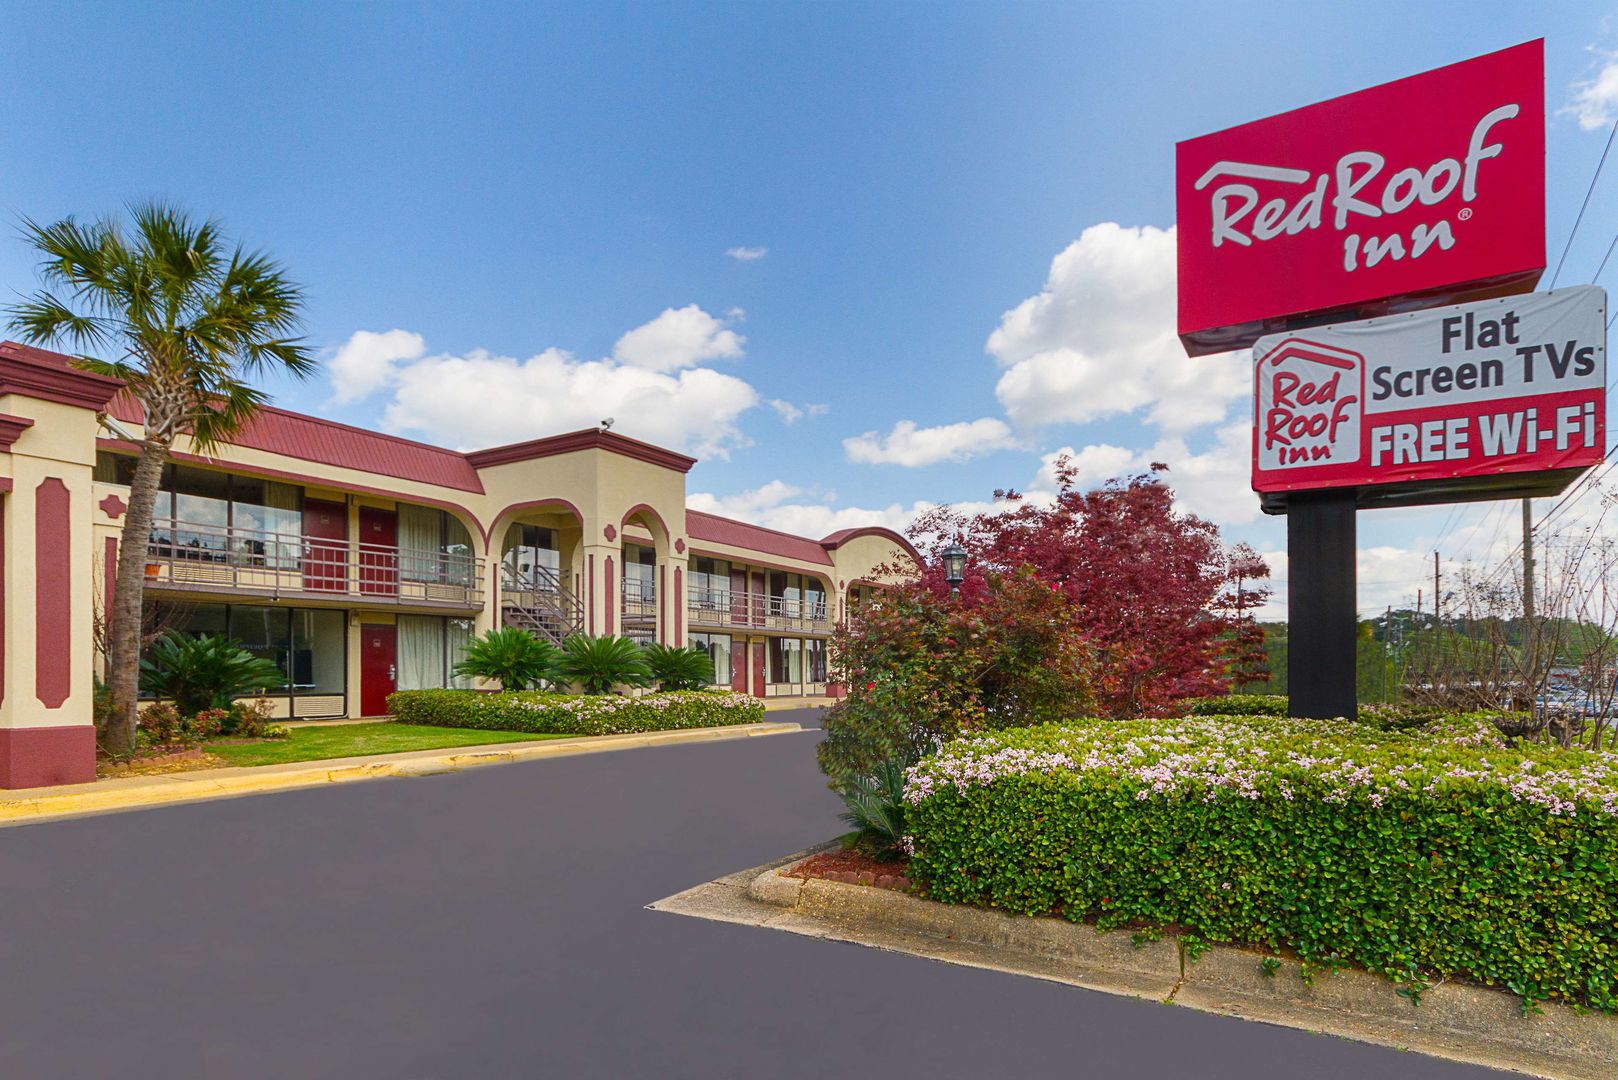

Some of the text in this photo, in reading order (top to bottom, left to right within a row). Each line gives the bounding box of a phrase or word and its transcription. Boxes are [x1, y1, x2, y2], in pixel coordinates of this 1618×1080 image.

[1211, 103, 1520, 248] Red Roof
[1441, 310, 1520, 354] Flat
[1271, 371, 1341, 409] Red
[1372, 340, 1595, 401] Screen TVs
[1265, 395, 1357, 450] Roof
[1370, 401, 1597, 468] FREE Wi-Fi
